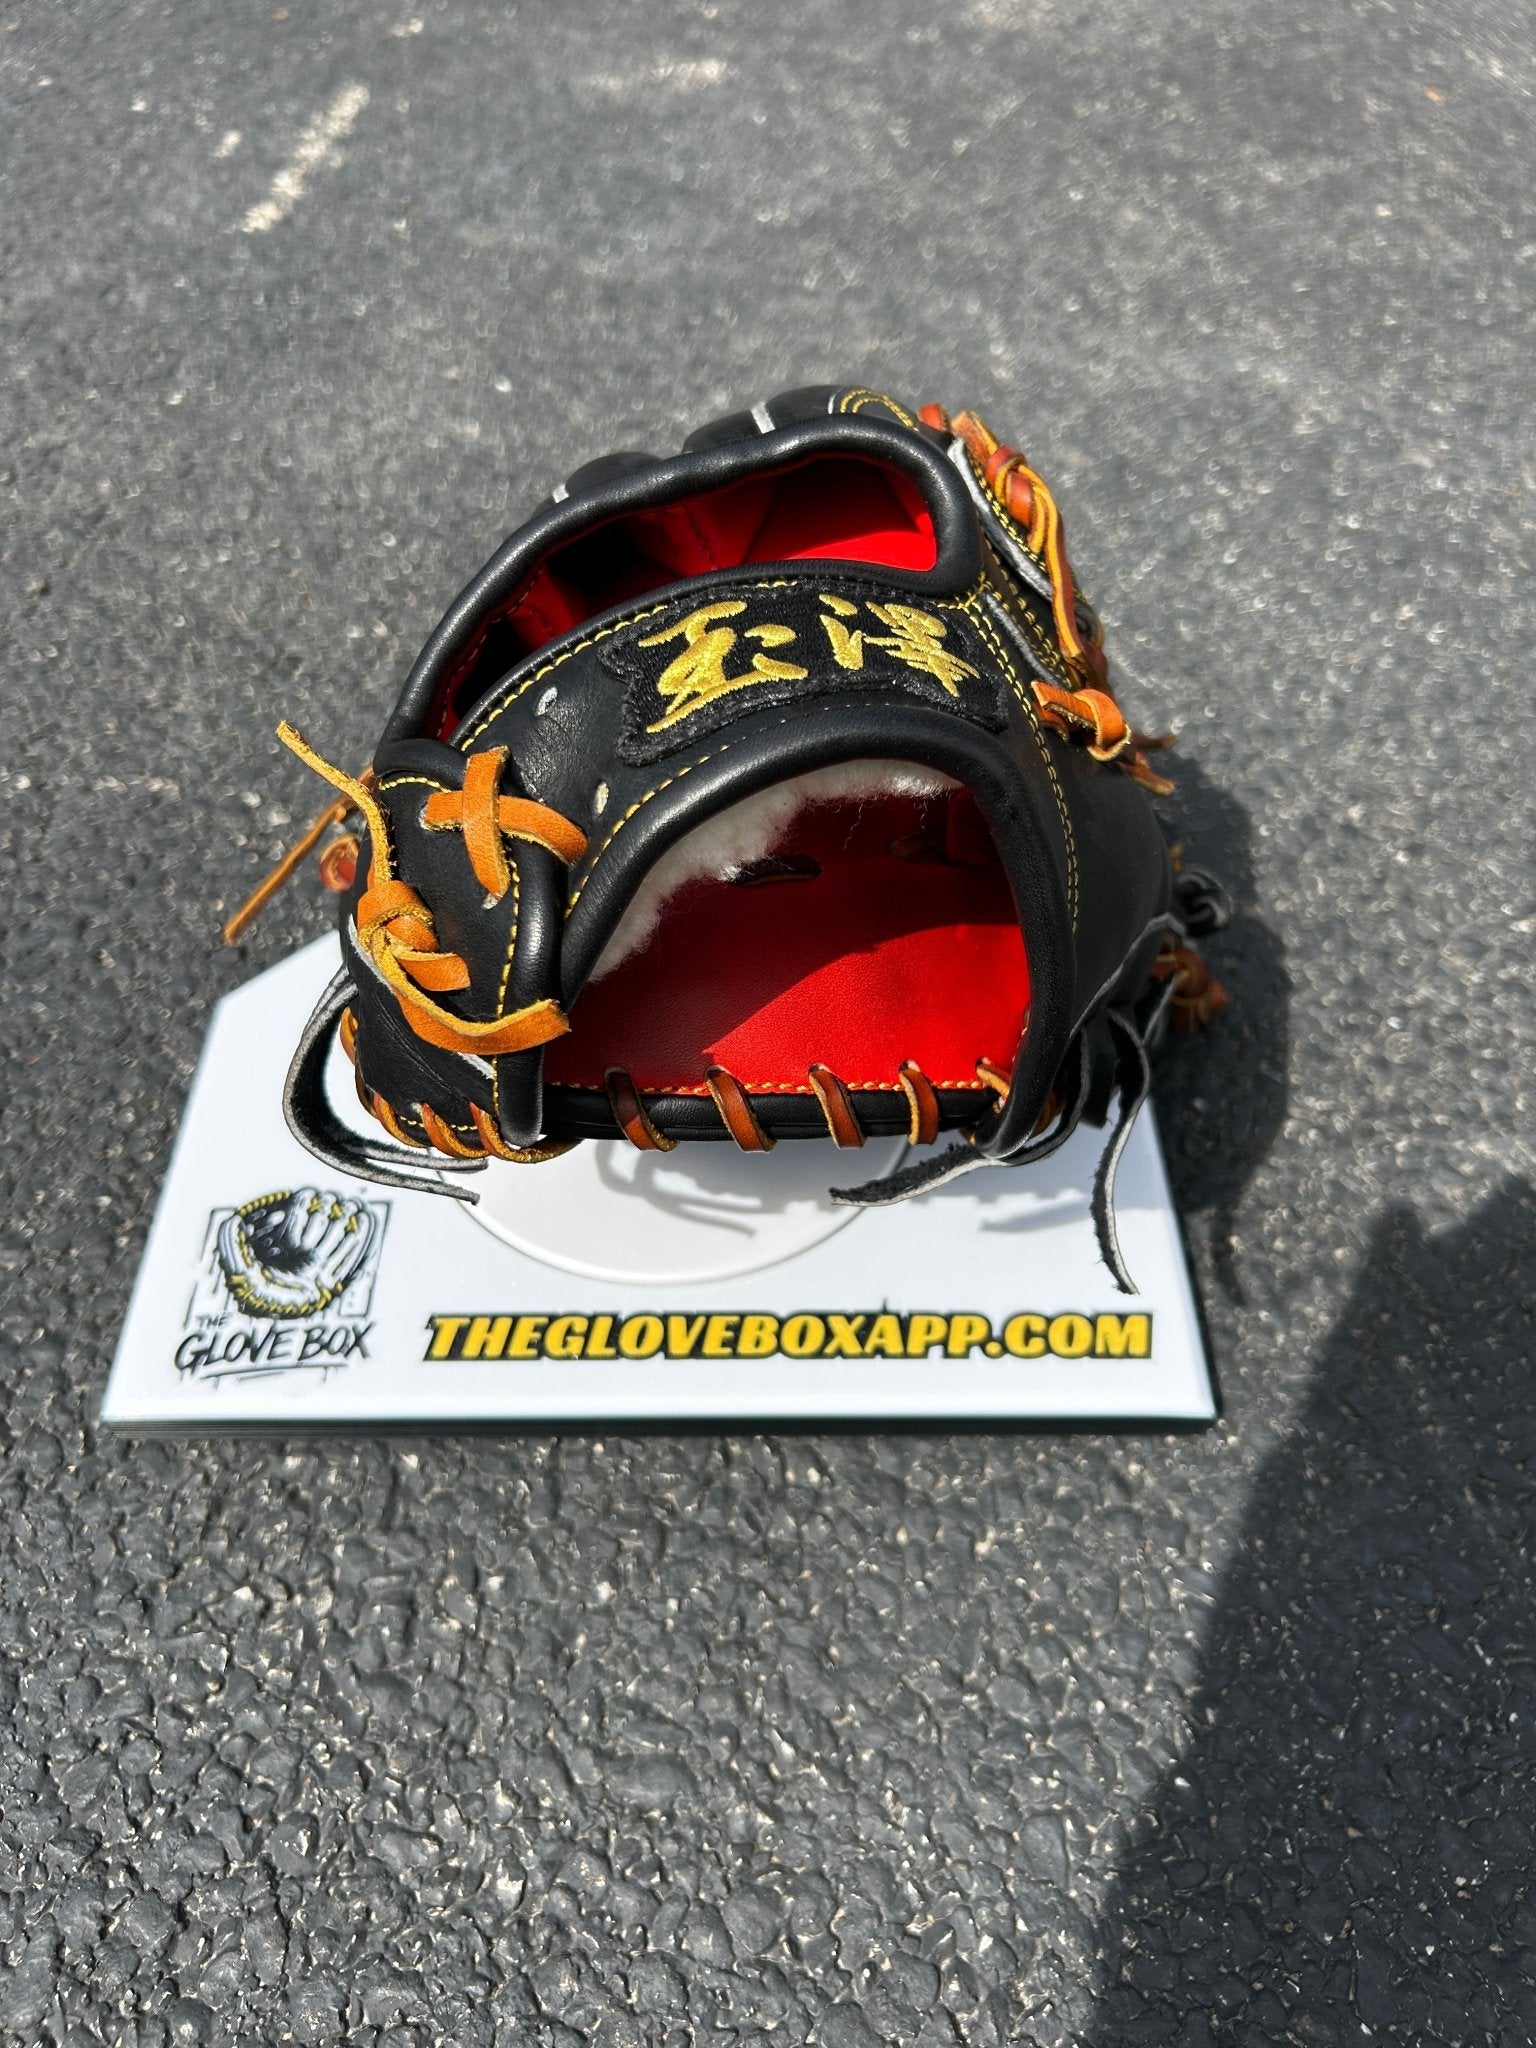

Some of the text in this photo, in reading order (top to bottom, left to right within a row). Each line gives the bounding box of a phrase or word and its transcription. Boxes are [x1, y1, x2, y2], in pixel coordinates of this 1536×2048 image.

[196, 1312, 231, 1328] THE
[423, 1311, 1152, 1362] THEGLOVEBOXAPP.COM
[174, 1322, 375, 1375] GLOVE BOX
